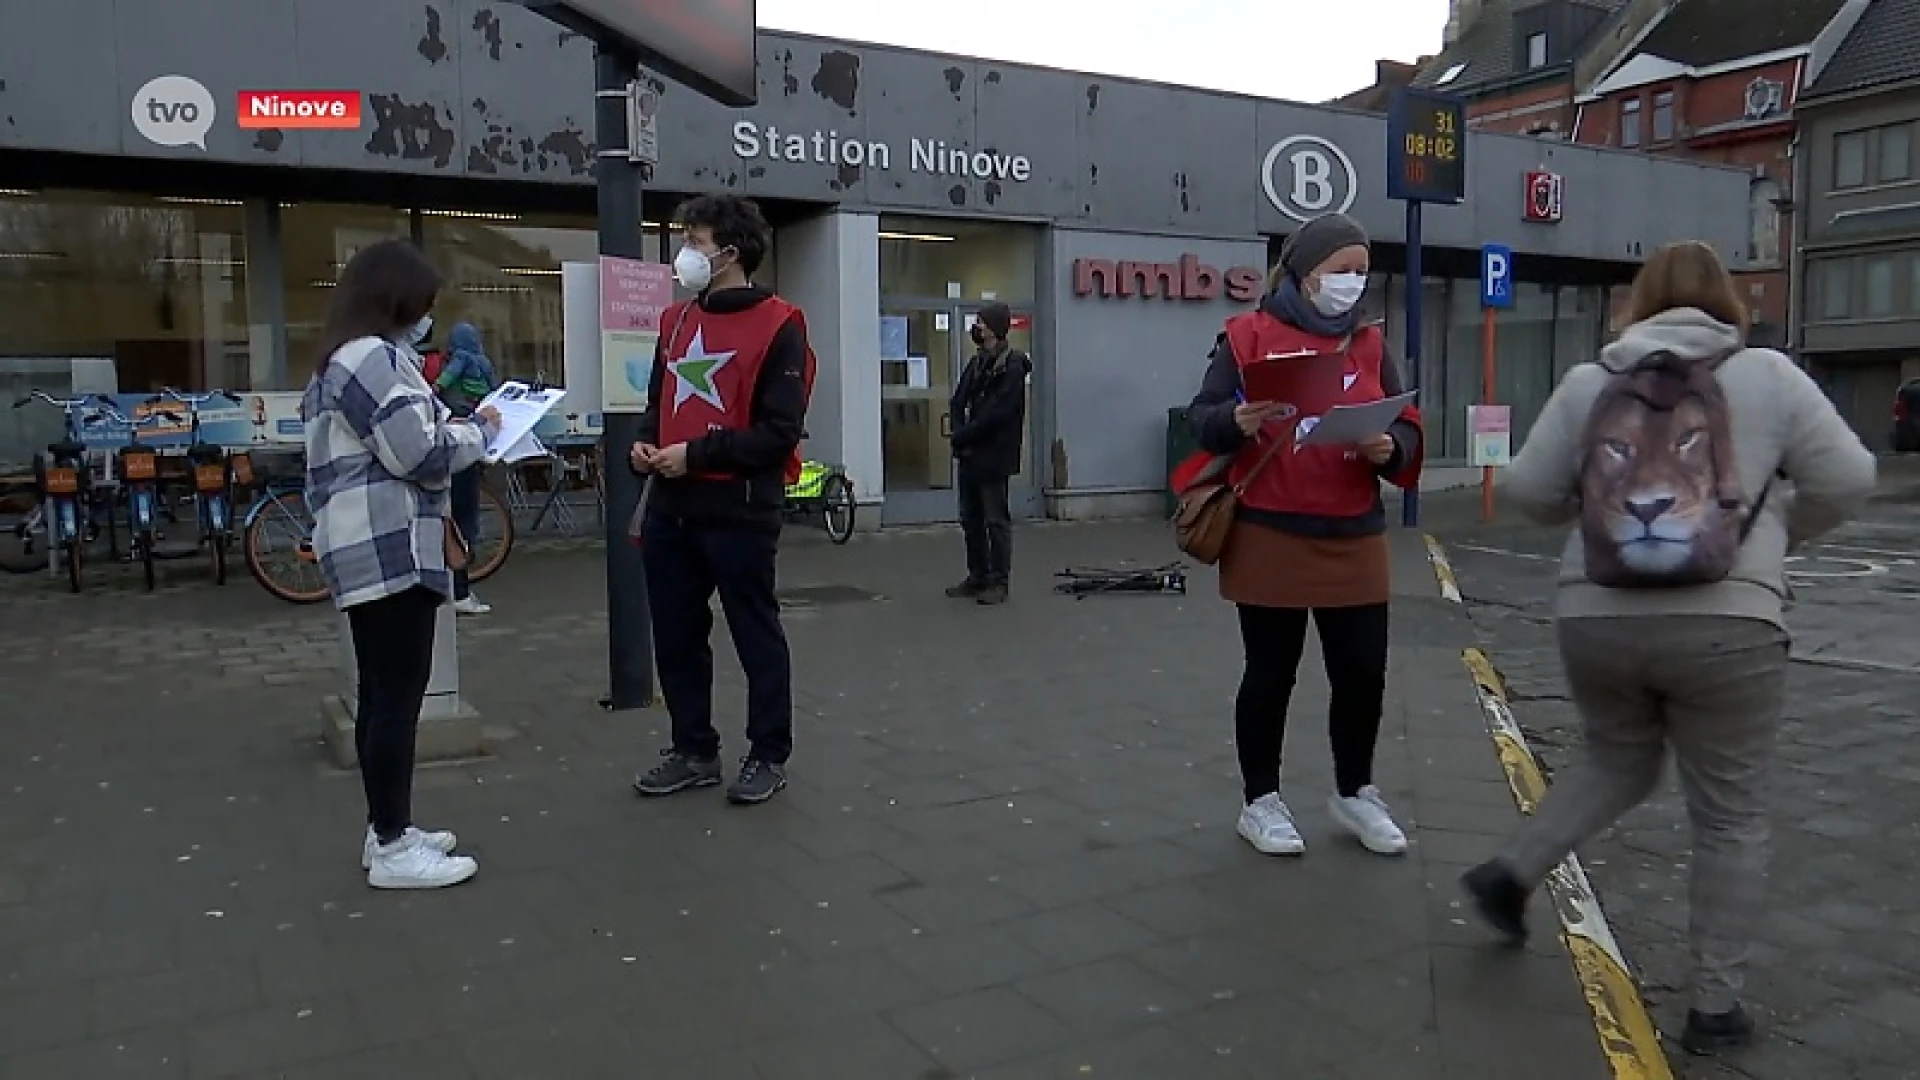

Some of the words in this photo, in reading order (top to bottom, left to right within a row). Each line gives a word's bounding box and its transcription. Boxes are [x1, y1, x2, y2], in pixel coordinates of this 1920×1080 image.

[1435, 112, 1455, 133] 31
[733, 121, 889, 169] Station
[911, 138, 1031, 181] Ninove
[1405, 133, 1456, 159] 08:02
[1290, 151, 1333, 210] B
[1073, 253, 1263, 303] nmbs
[1488, 254, 1506, 295] P
